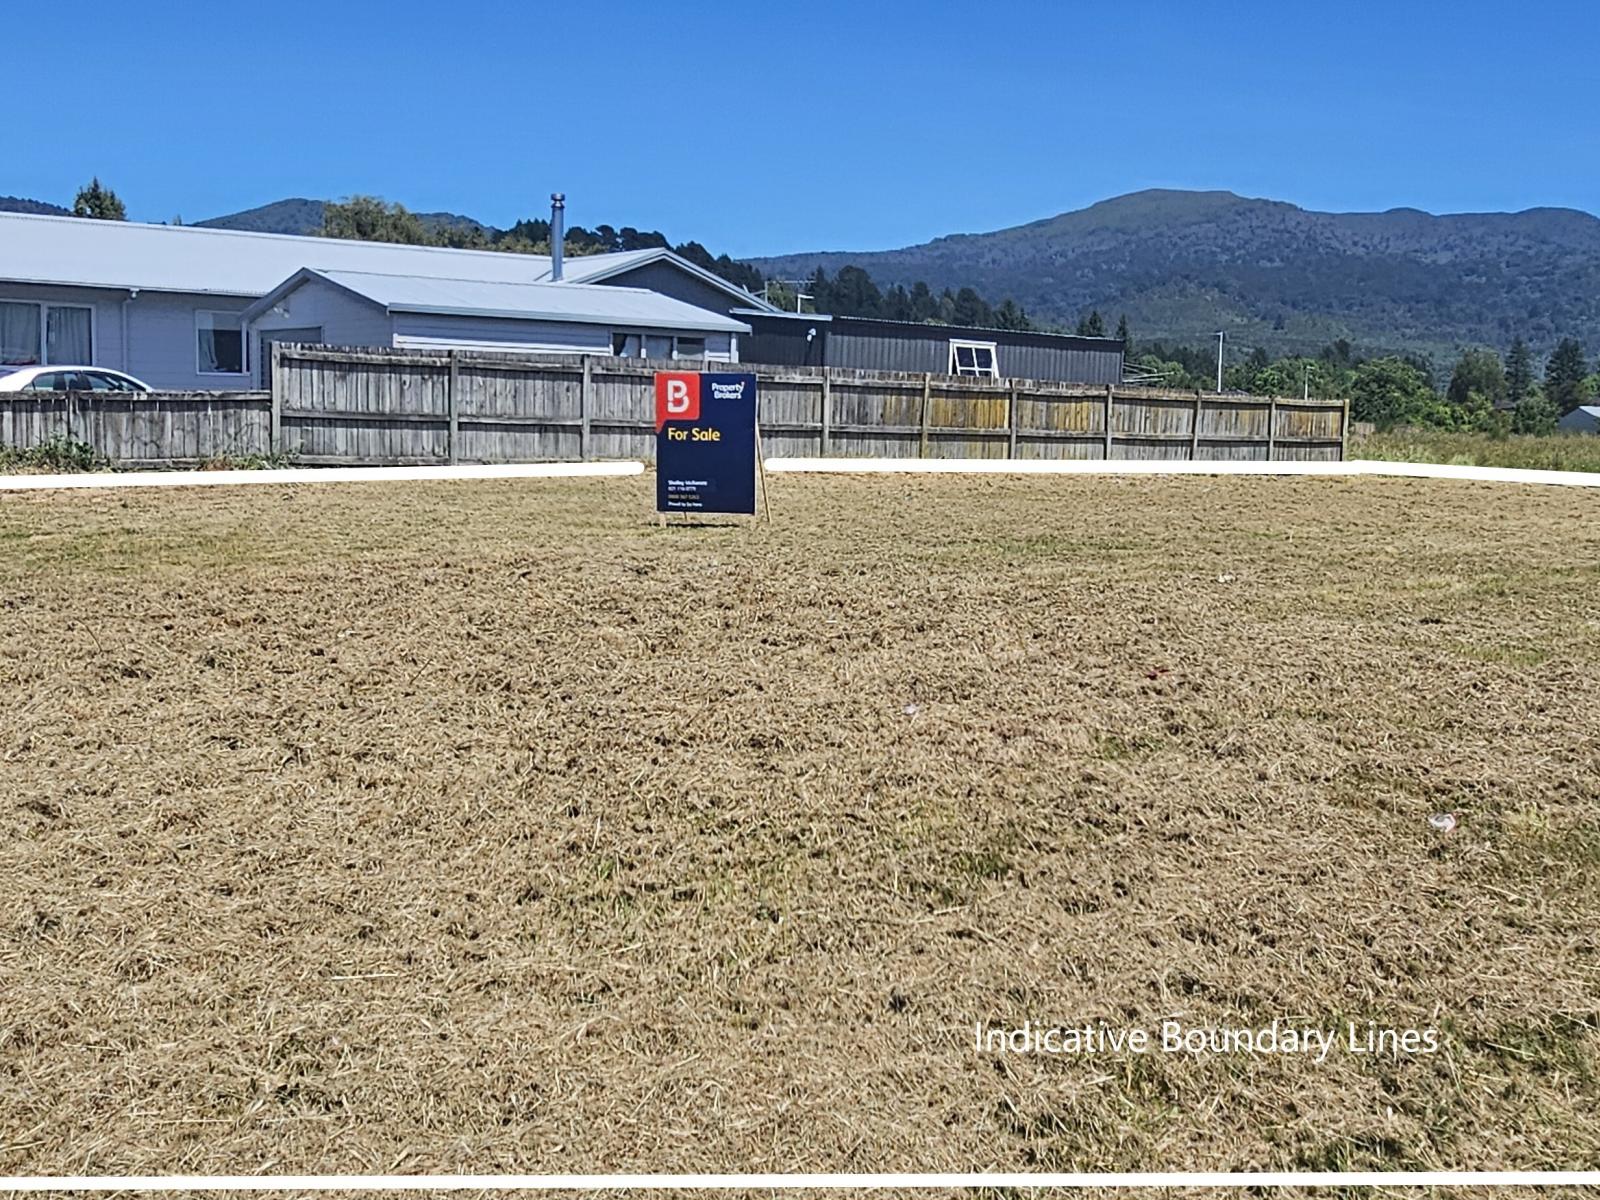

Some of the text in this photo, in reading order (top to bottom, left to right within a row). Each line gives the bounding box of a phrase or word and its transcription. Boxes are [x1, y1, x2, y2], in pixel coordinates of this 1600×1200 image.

[712, 382, 745, 392] Property
[668, 380, 690, 413] B
[714, 391, 742, 399] Brokers
[668, 427, 721, 441] For Sale
